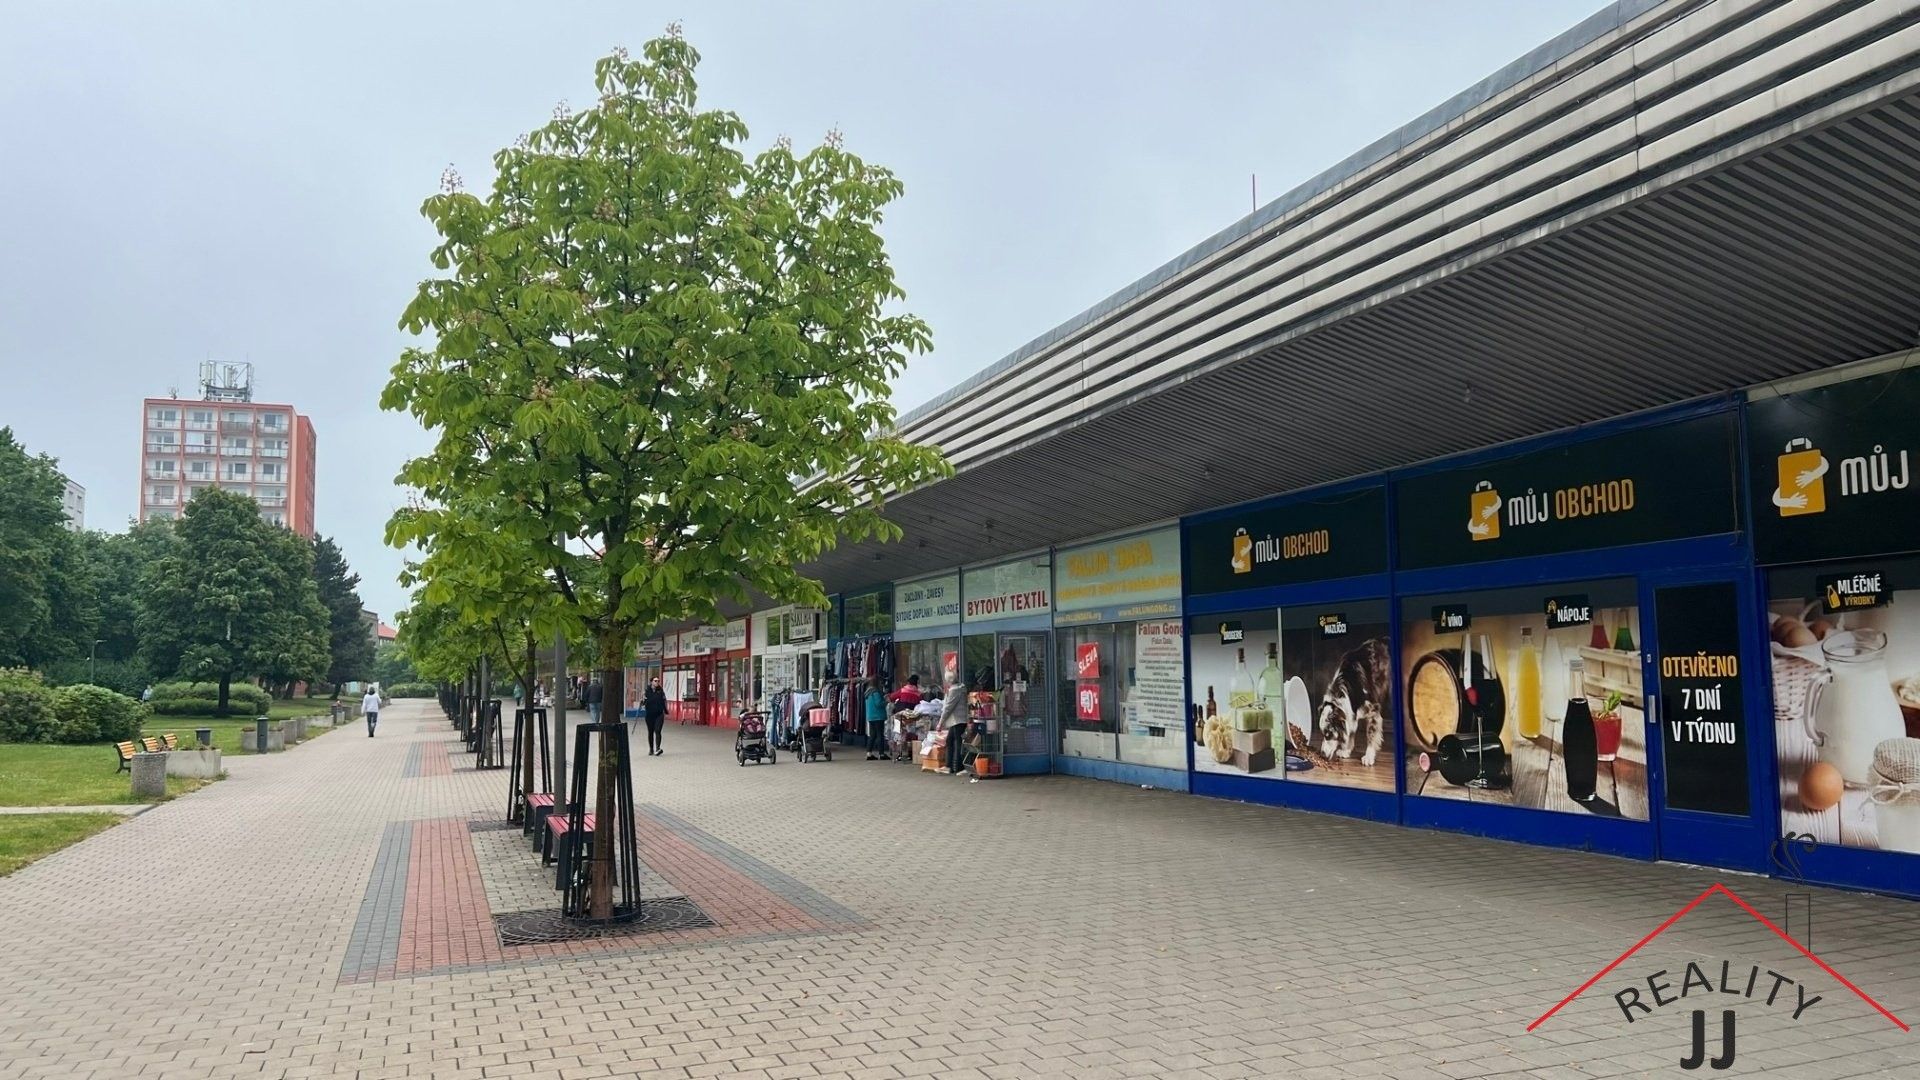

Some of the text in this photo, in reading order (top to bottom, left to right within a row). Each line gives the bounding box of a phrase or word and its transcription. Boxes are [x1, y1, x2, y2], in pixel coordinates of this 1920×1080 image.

[1840, 444, 1909, 496] MŮJ
[1508, 479, 1634, 527] MŮJ OBCHOD
[1255, 529, 1329, 564] MŮJ OBCHOD
[1837, 574, 1882, 595] MLÉČNÉ
[967, 590, 1049, 617] BYTOVÝ TEXTIL
[1557, 605, 1590, 623] NÁPOJE
[1844, 595, 1877, 607] VÝROBKY
[1138, 623, 1160, 636] Falun
[1447, 613, 1463, 628] VÍNO
[1078, 646, 1098, 675] SLEVA
[1662, 650, 1738, 677] OTEVŘENO
[1681, 683, 1721, 710] 7 DNÍ
[1671, 716, 1736, 744] V TÝDNU
